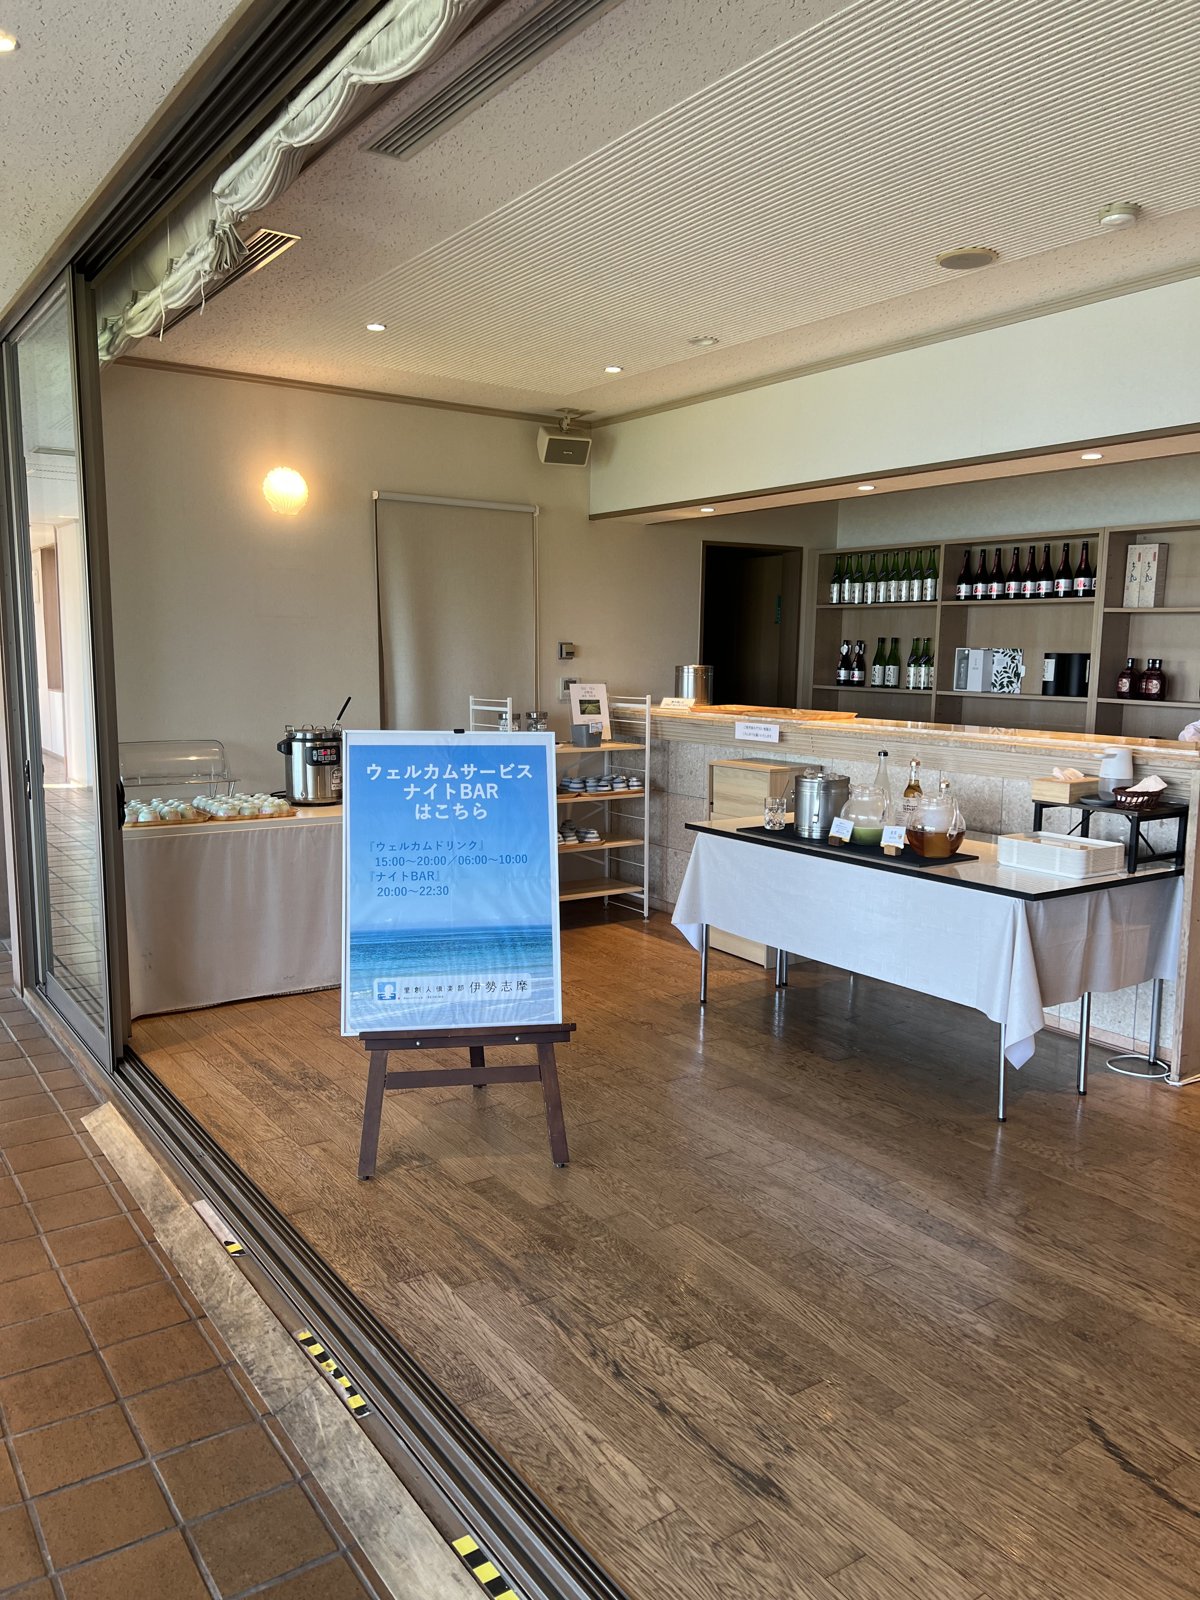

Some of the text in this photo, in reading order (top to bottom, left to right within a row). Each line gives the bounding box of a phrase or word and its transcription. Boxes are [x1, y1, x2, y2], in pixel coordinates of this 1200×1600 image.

[366, 763, 533, 781] ウェルカムサービス
[403, 783, 499, 800] ナイトBAR
[415, 802, 488, 820] はこちら
[469, 979, 528, 994] 伊勢志摩
